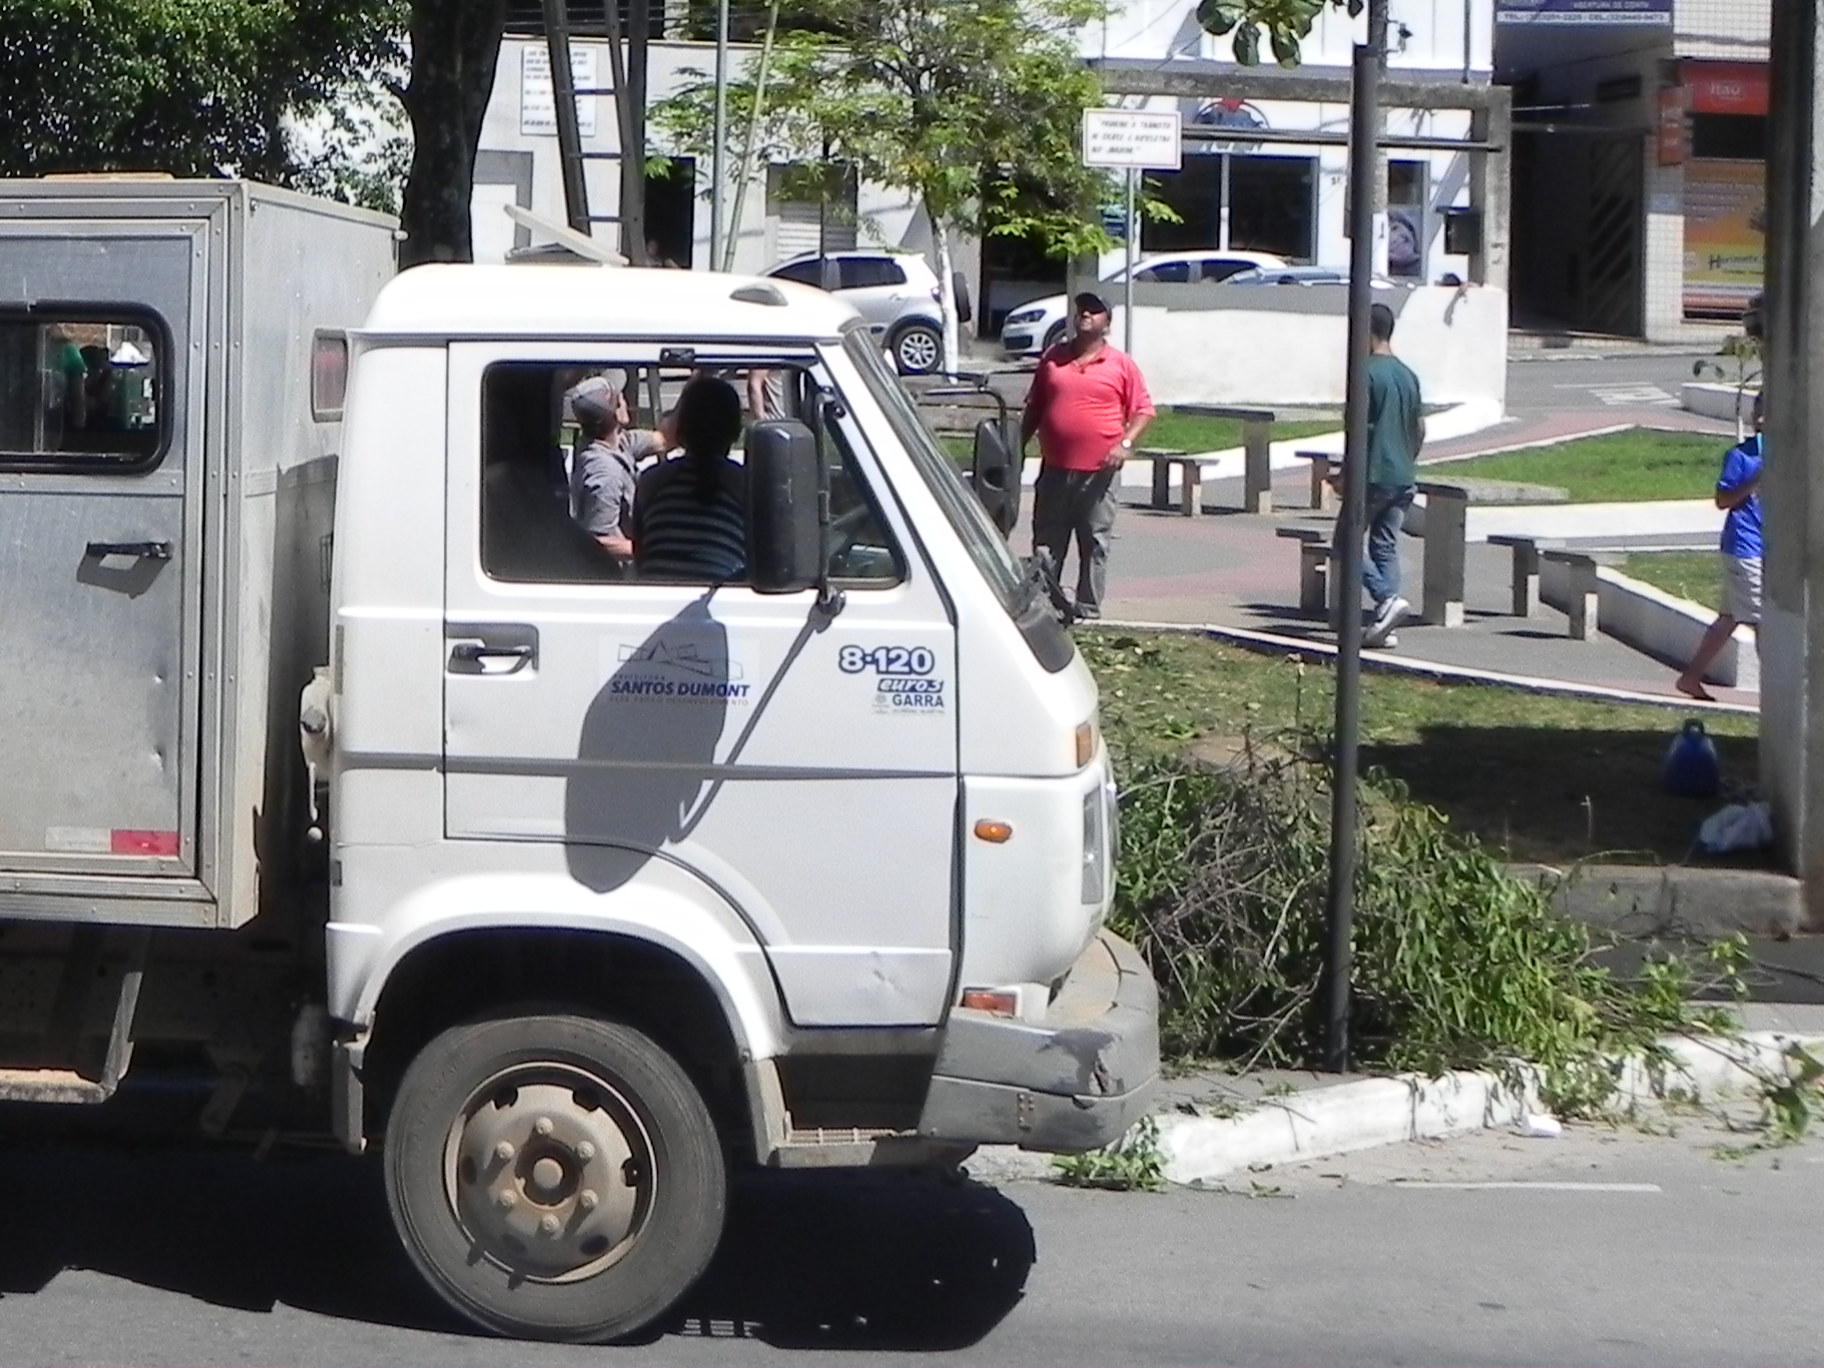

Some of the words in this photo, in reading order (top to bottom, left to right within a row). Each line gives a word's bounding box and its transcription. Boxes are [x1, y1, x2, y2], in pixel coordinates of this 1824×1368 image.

[612, 681, 674, 695] SANTOS
[677, 683, 750, 698] DUMONT
[878, 678, 944, 693] euro3
[892, 694, 945, 708] GARRA
